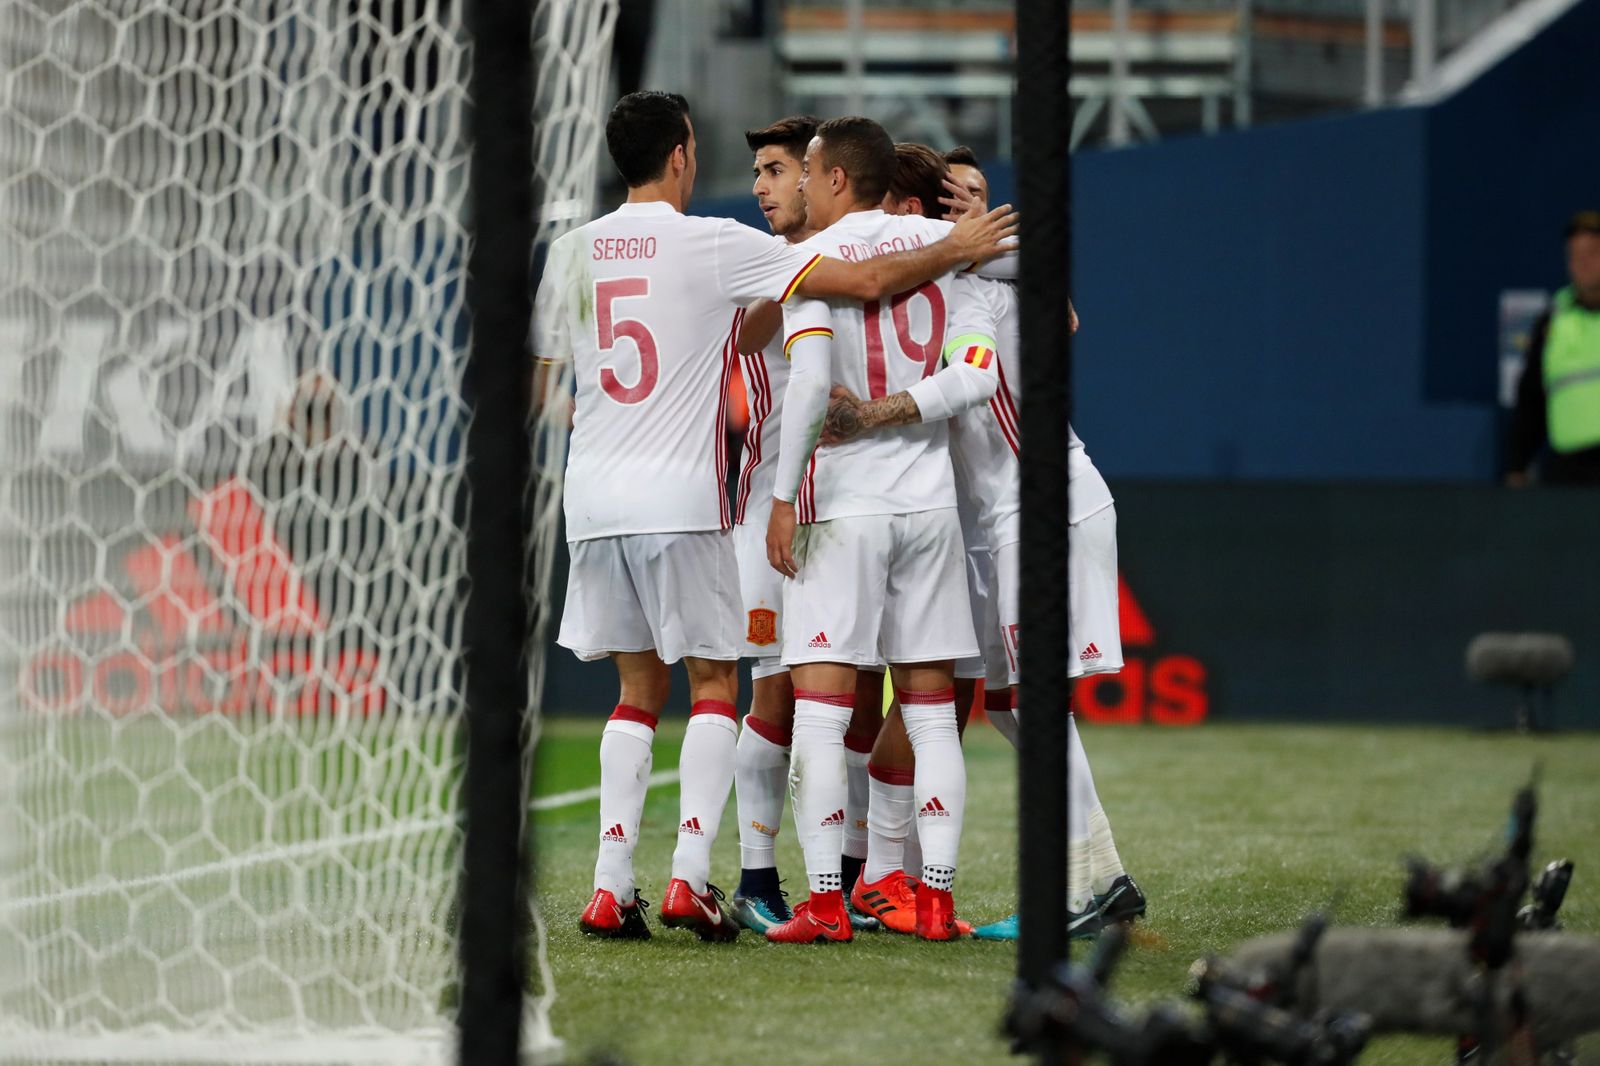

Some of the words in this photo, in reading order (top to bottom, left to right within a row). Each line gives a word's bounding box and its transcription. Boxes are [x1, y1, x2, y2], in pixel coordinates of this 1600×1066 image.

[592, 237, 656, 260] SERGIO
[594, 276, 659, 405] 5
[863, 279, 946, 400] 19
[1080, 652, 1102, 661] adidas
[918, 809, 950, 818] adidas
[679, 826, 704, 836] adidas
[602, 834, 627, 844] adidas
